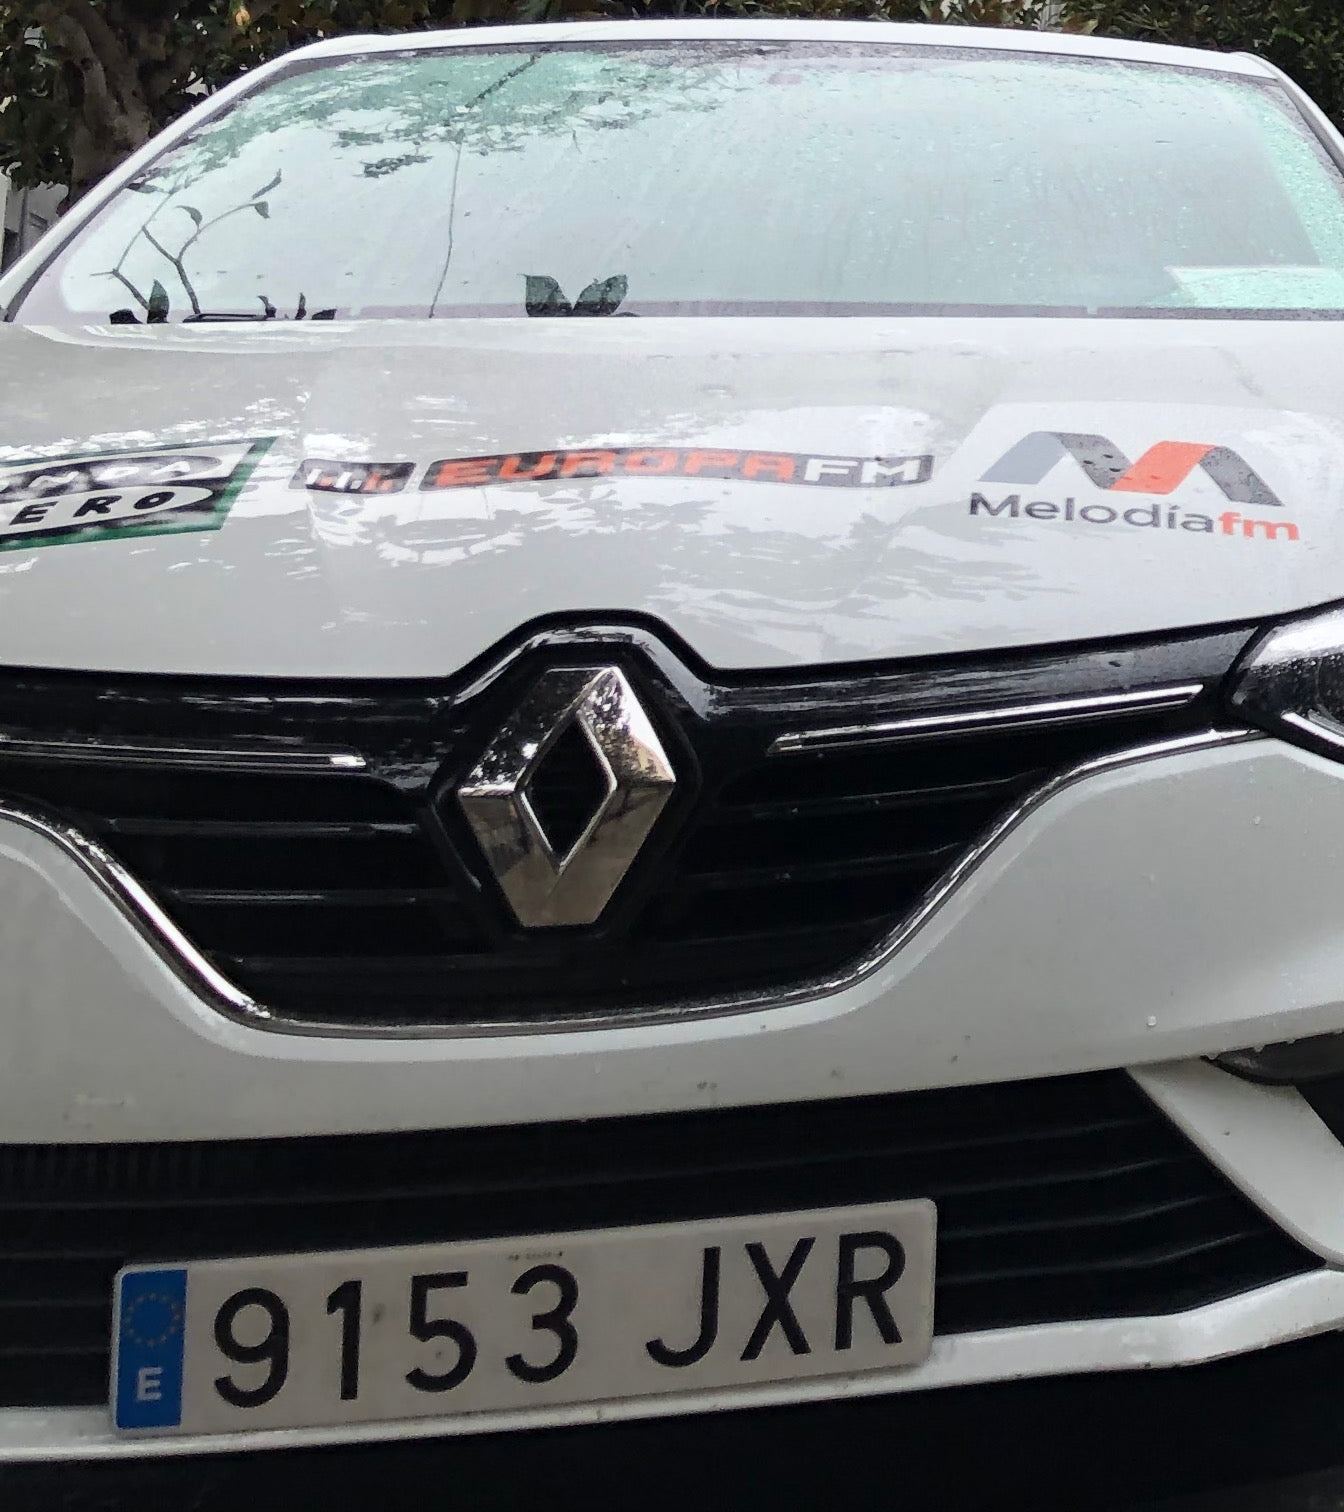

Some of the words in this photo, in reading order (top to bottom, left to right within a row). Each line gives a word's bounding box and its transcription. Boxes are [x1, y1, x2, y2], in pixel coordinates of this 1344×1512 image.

[213, 1262, 580, 1408] 9153
[644, 1230, 906, 1368] JXR
[135, 1366, 163, 1402] E
